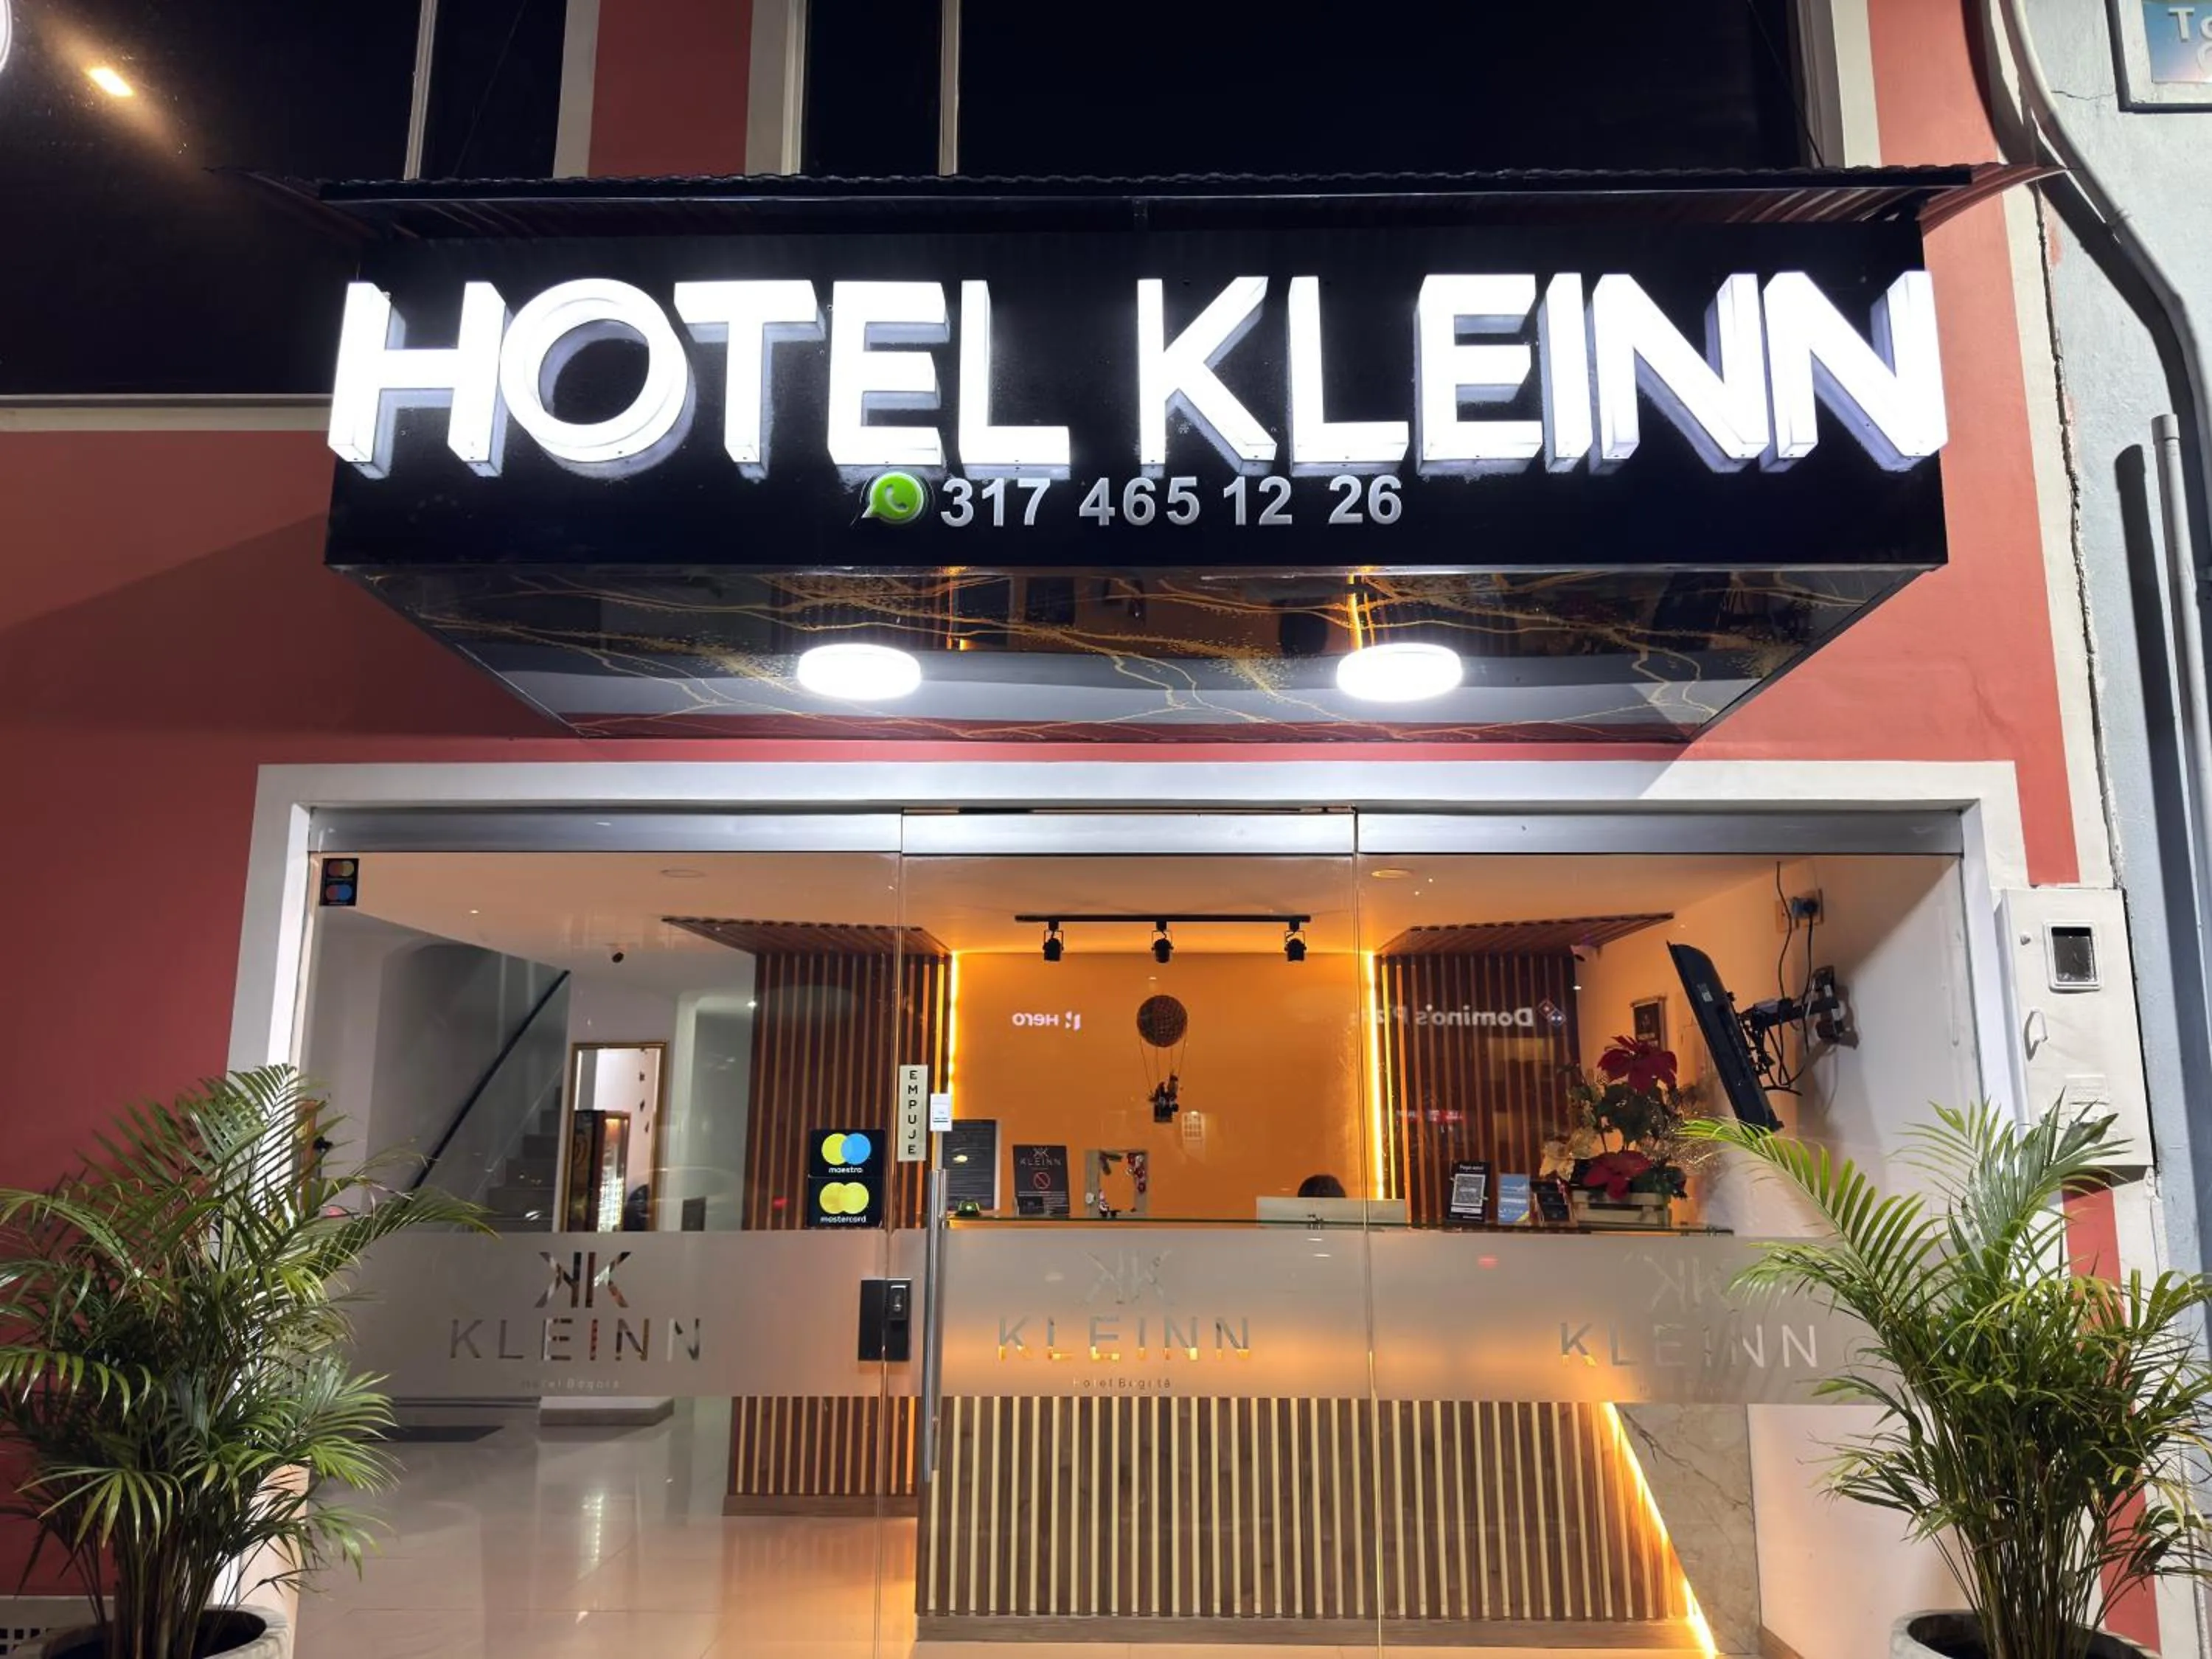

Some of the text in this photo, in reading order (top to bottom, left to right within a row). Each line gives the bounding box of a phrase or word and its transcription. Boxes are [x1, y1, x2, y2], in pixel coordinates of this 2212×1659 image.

[327, 271, 1948, 477] HOTEL KLEINN
[940, 475, 1403, 526] 317 465 12 26
[908, 1070, 918, 1155] EMPUJE
[820, 1214, 867, 1223] mastercard
[450, 1318, 700, 1361] KLEINN
[998, 1316, 1250, 1361] KLEINN
[1559, 1322, 1818, 1368] KLEINN
